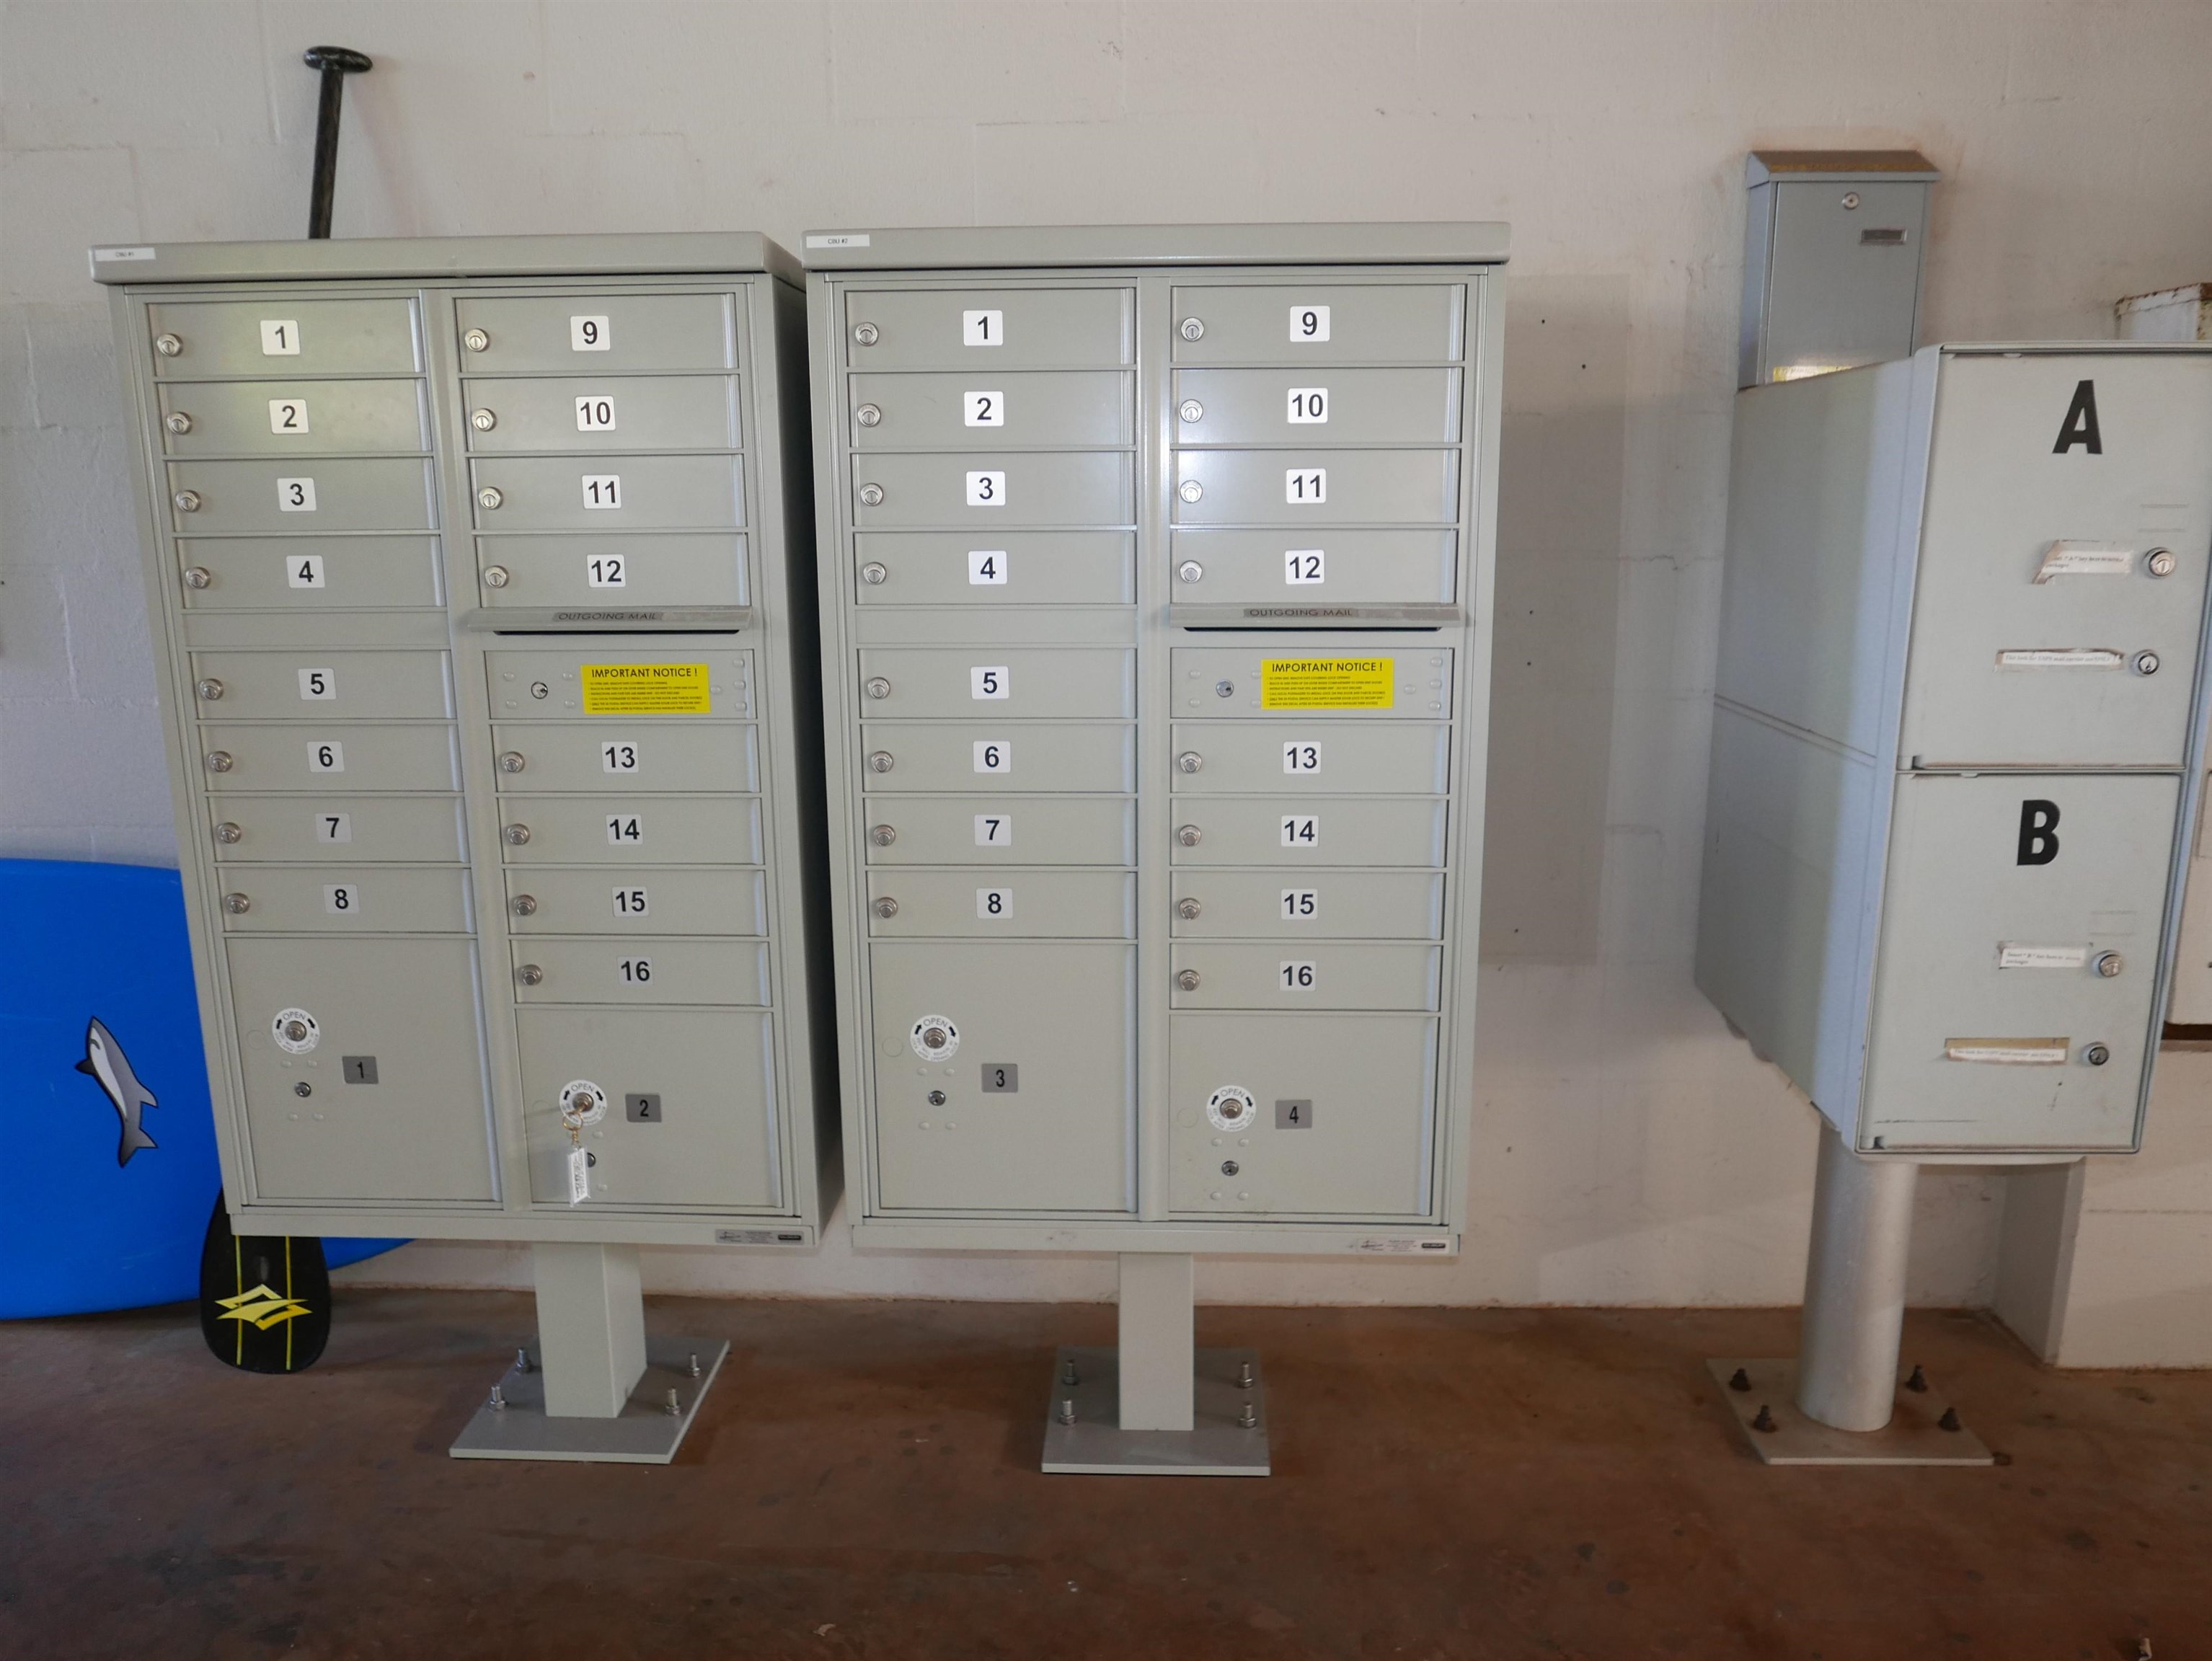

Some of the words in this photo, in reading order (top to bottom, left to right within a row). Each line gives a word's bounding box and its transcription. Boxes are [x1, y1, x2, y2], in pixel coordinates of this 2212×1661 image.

[583, 321, 598, 345] 9
[978, 316, 988, 340] 1
[1302, 311, 1318, 336] 9
[275, 326, 286, 349] 1
[282, 405, 297, 428] 2
[580, 402, 611, 425] 10
[977, 397, 992, 420] 2
[1292, 394, 1324, 417] 10
[2052, 379, 2102, 455] A
[290, 483, 304, 506] 3
[588, 481, 616, 504] 11
[979, 477, 994, 500] 3
[1292, 474, 1320, 498] 11
[298, 560, 314, 583] 4
[591, 560, 621, 583] 12
[980, 557, 996, 579] 4
[1289, 556, 1320, 579] 12
[558, 612, 624, 621] OUTGOING
[591, 668, 650, 678] IMPORTANT
[653, 668, 691, 677] NOTICE
[1272, 663, 1333, 672] IMPORTANT
[1337, 663, 1376, 671] NOTICE
[311, 673, 324, 695] 5
[983, 672, 998, 694] 5
[319, 745, 333, 767] 6
[605, 746, 635, 769] 13
[984, 745, 999, 768] 6
[1287, 747, 1317, 769] 13
[325, 817, 340, 838] 7
[609, 818, 640, 840] 14
[986, 820, 1000, 841] 7
[1284, 820, 1315, 842] 14
[2017, 800, 2061, 866] B
[335, 889, 349, 910] 8
[616, 891, 645, 912] 15
[988, 892, 1002, 914] 8
[1284, 893, 1314, 915] 15
[621, 960, 650, 982] 16
[1283, 965, 1313, 986] 16
[282, 1011, 306, 1020] OPEN
[923, 1018, 948, 1027] OPEN
[357, 1061, 364, 1078] 1
[996, 1069, 1005, 1088] 3
[571, 1083, 595, 1092] OPEN
[1221, 1088, 1245, 1098] OPEN
[640, 1099, 649, 1117] 2
[1289, 1106, 1299, 1124] 4
